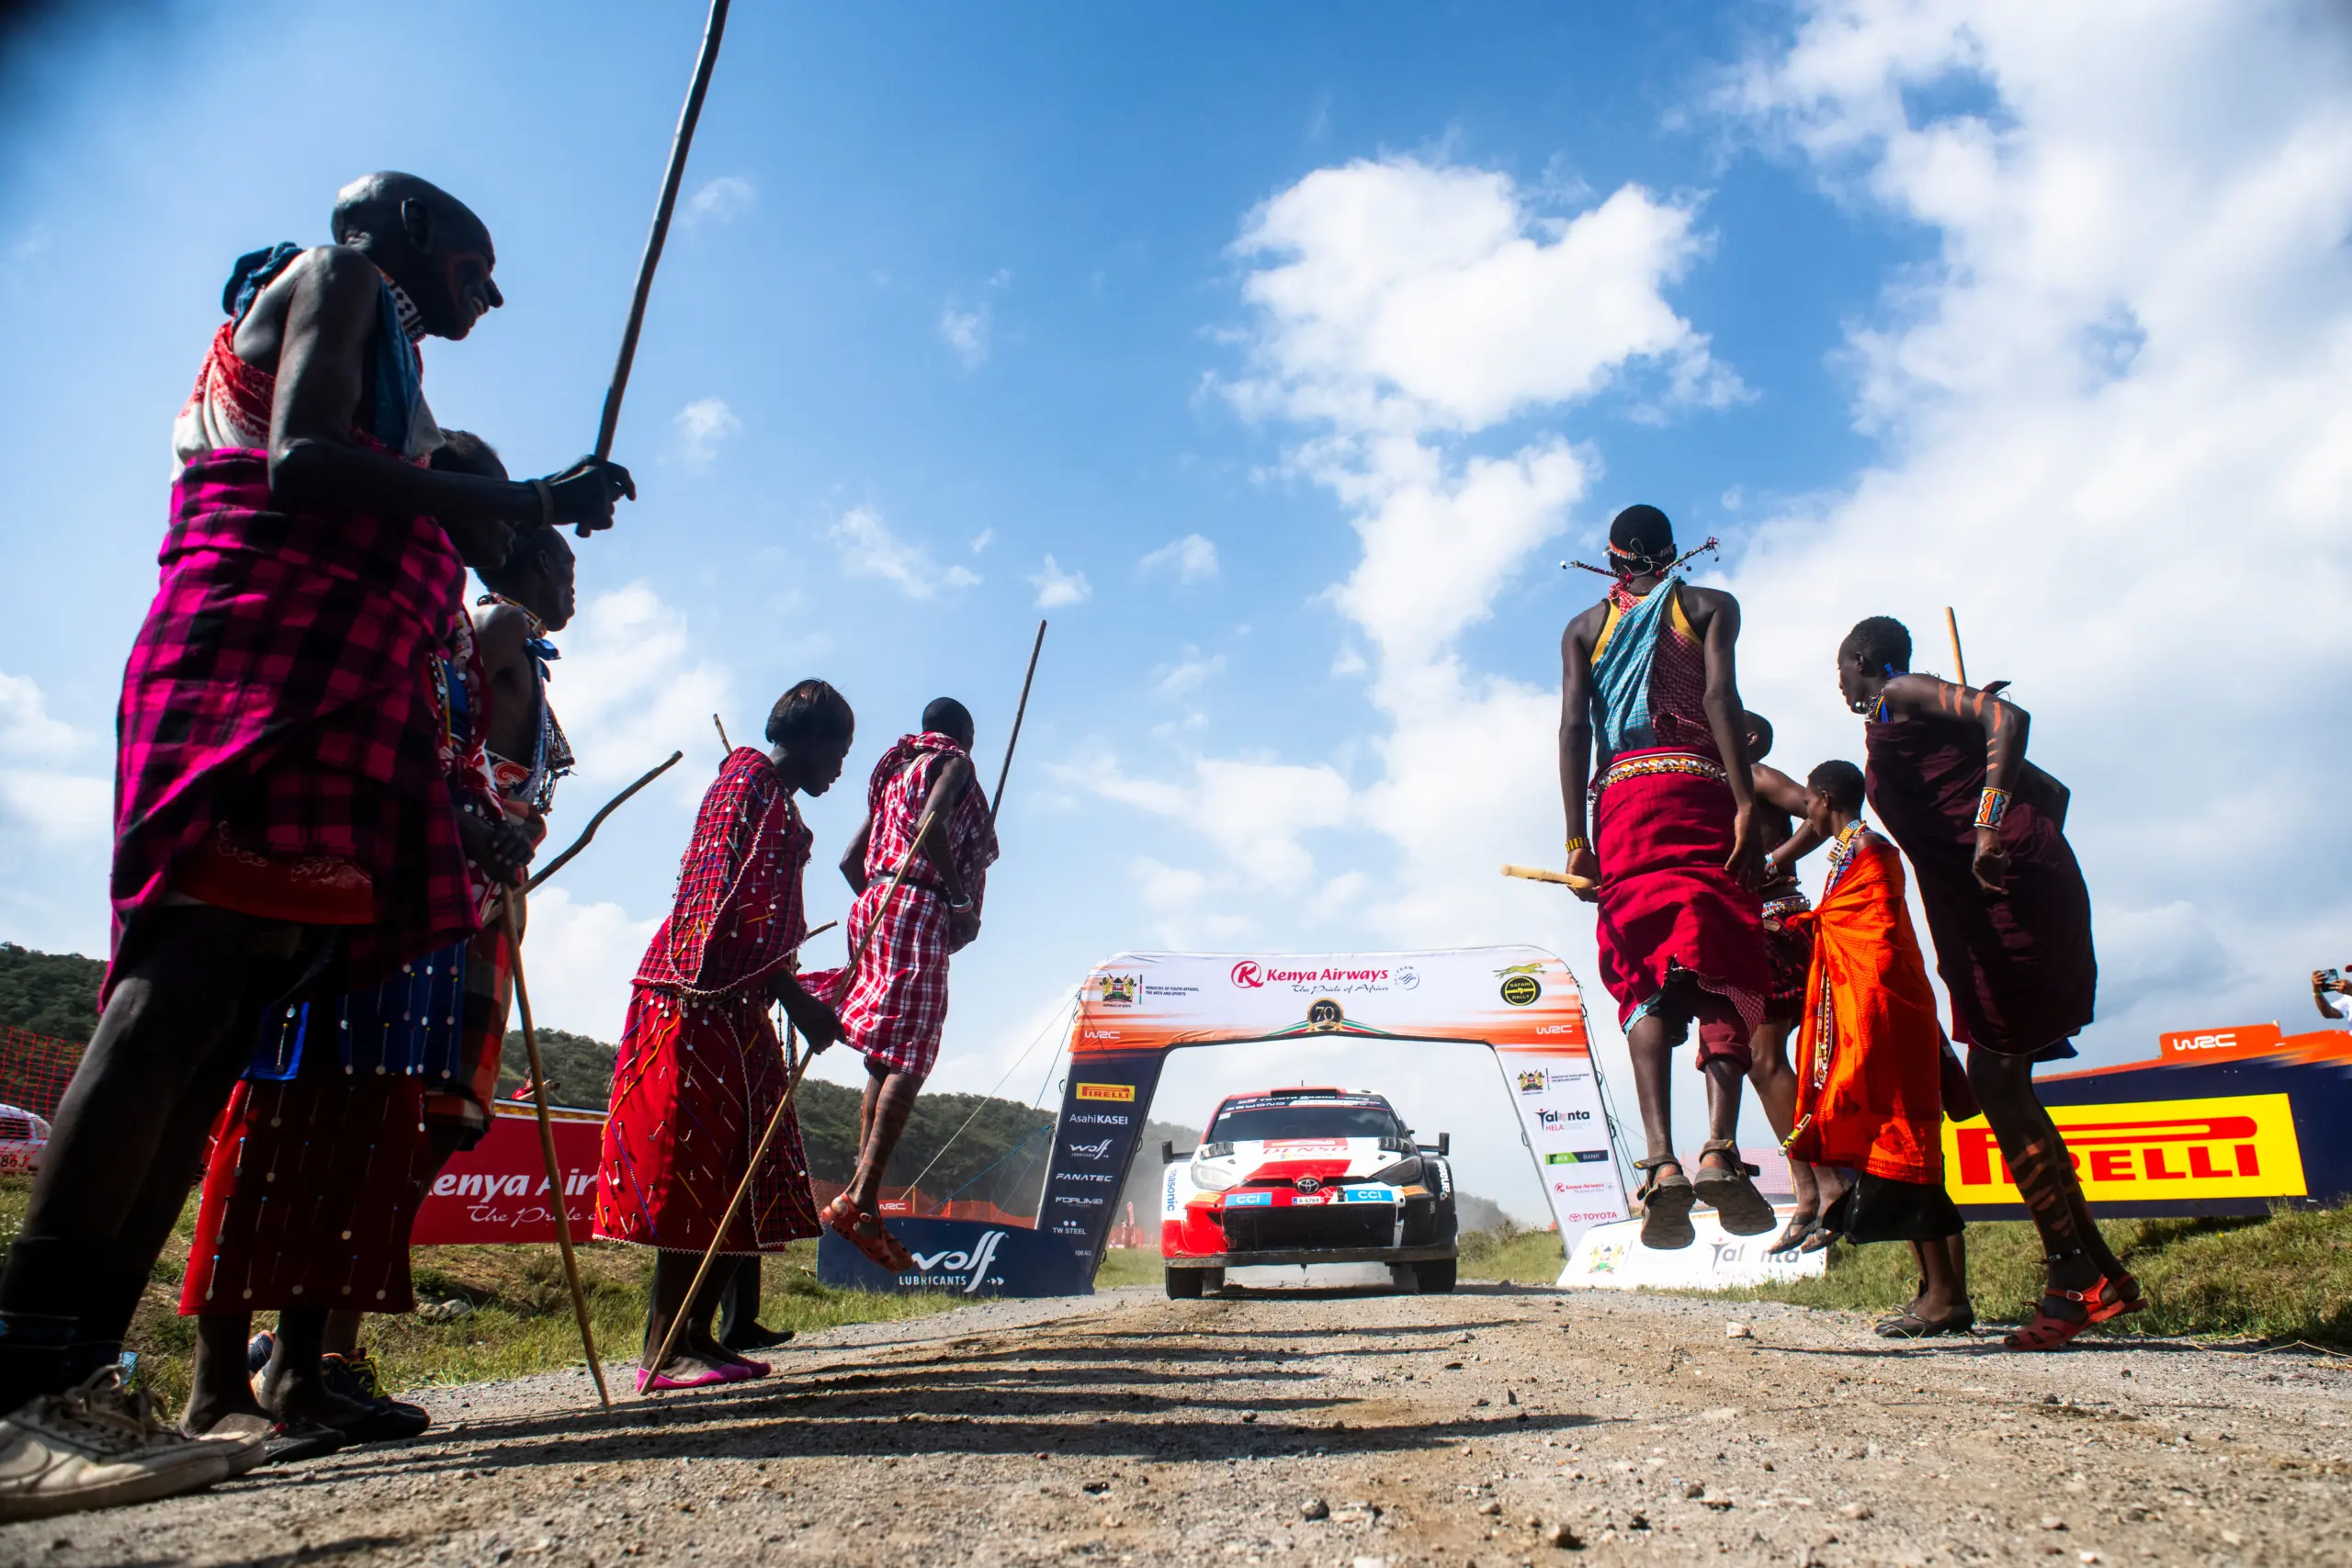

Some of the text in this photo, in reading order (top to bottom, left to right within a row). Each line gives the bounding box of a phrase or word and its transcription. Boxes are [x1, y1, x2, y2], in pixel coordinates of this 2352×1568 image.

[1266, 969, 1317, 983] Kenya
[1320, 968, 1388, 982] Airways
[1291, 984, 1389, 994] The Pride of Africa
[1315, 1006, 1334, 1021] 70
[1085, 1030, 1120, 1039] WRC
[1536, 1025, 1573, 1035] WRC
[2173, 1034, 2237, 1051] WRC
[1082, 1086, 1130, 1098] PIRELLI
[1069, 1114, 1128, 1125] AsahiKASEI
[1056, 1173, 1113, 1182] FANATEC
[427, 1174, 530, 1203] enya
[1236, 1195, 1260, 1203] CCI
[1358, 1191, 1382, 1199] CCI
[467, 1205, 509, 1222] The
[1584, 1212, 1617, 1220] TOYOTA
[899, 1275, 967, 1286] LUBRICANTS
